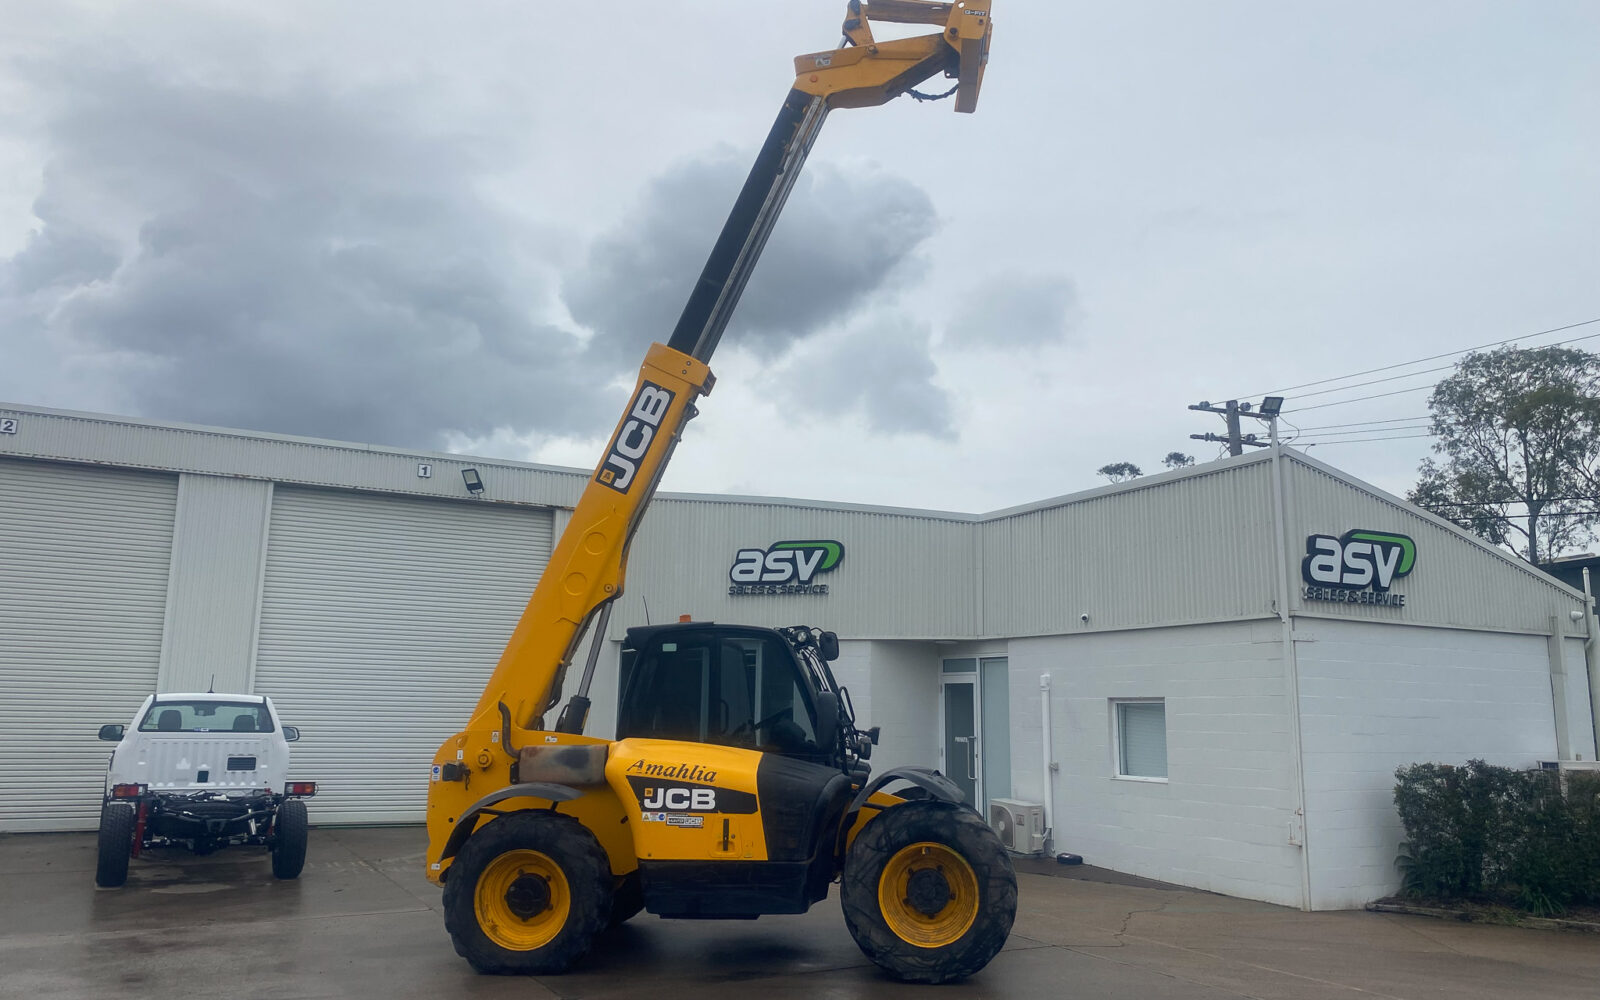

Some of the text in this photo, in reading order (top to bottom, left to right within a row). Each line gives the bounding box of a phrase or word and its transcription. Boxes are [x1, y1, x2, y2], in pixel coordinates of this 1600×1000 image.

[3, 420, 13, 432] 2
[608, 386, 670, 489] JCB
[766, 585, 777, 595] &
[780, 584, 829, 595] SERVICE
[1347, 590, 1359, 604] &
[1360, 591, 1405, 607] SERVICE
[626, 758, 718, 783] Amahlia
[644, 787, 716, 810] JCB
